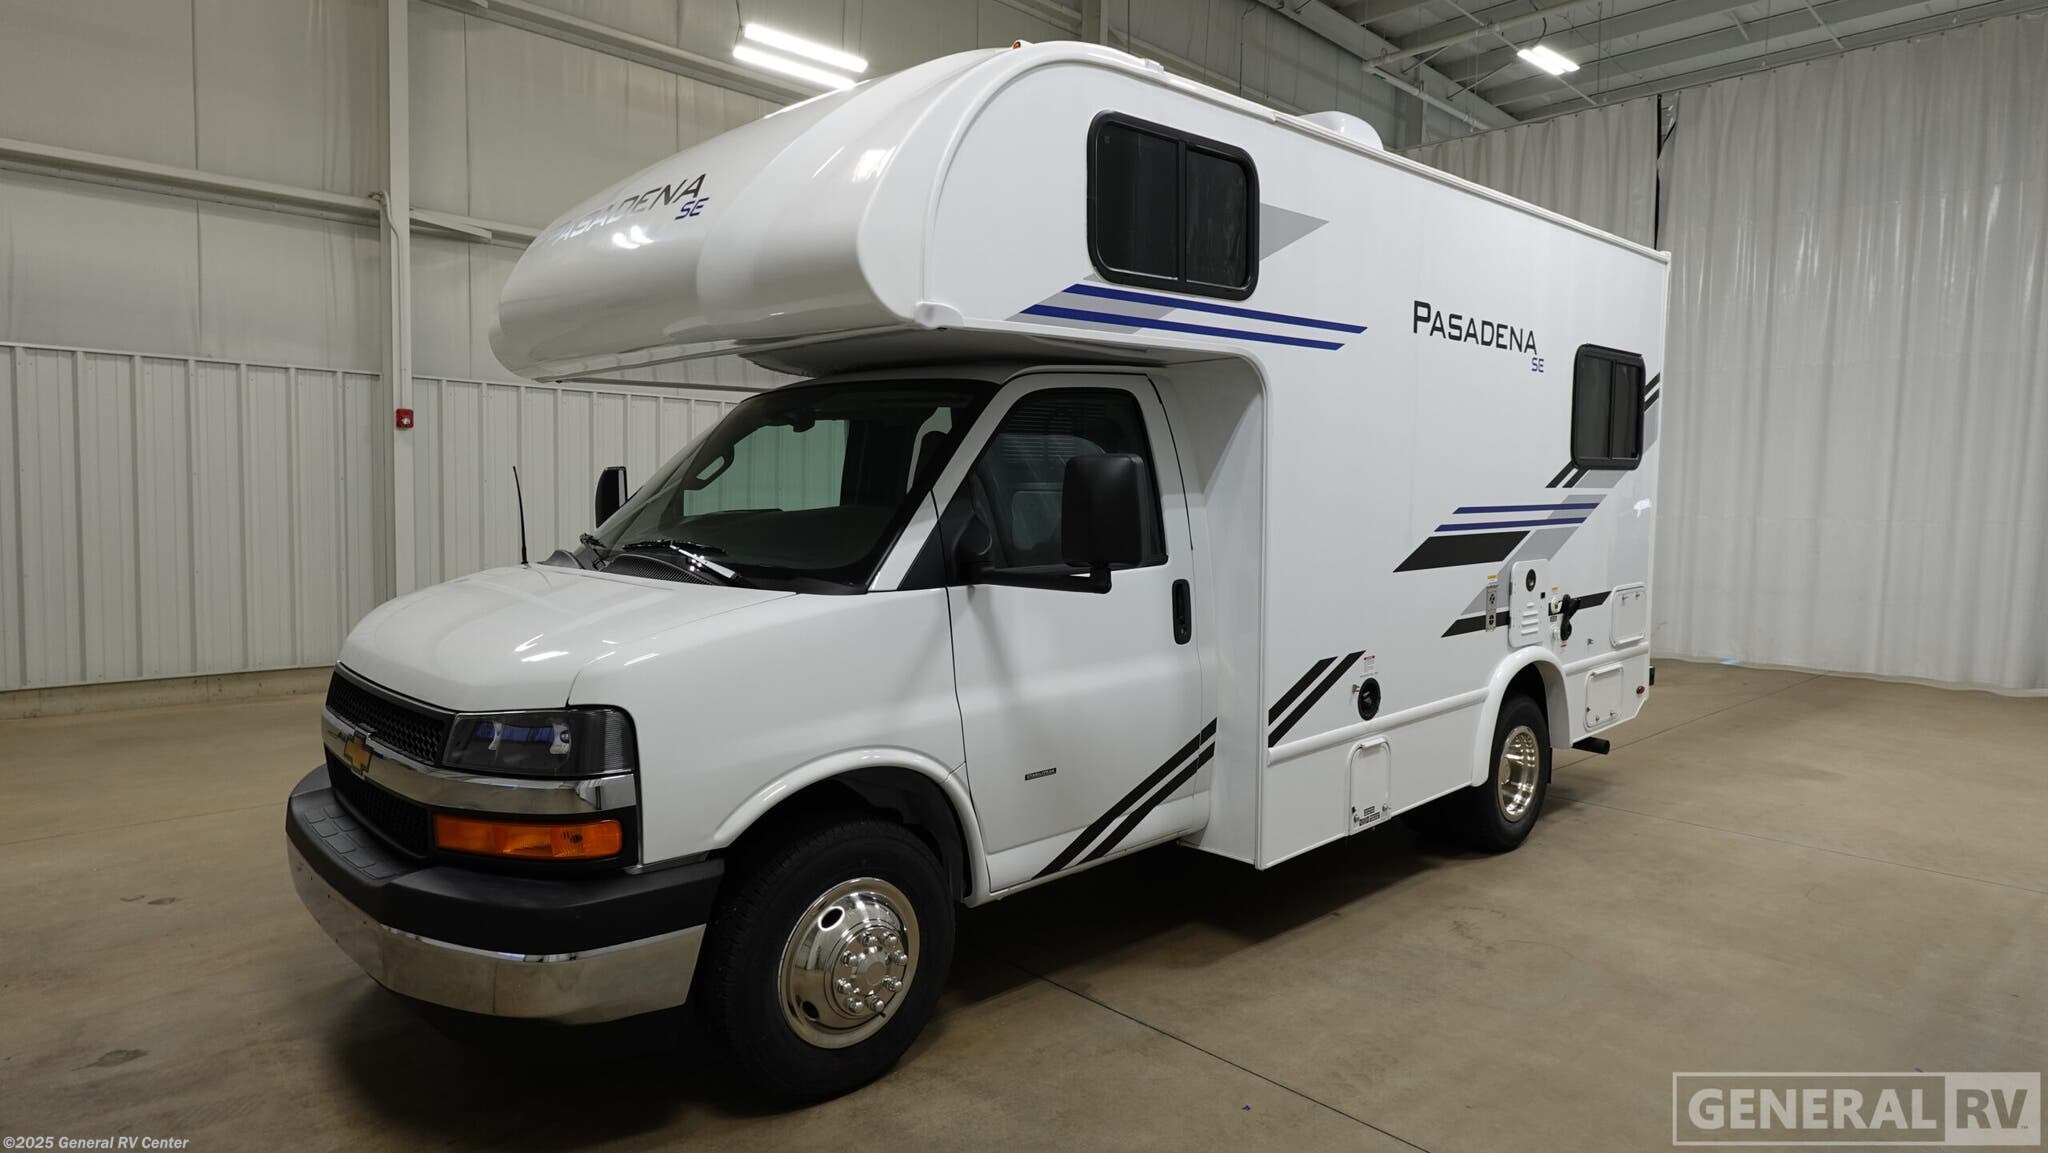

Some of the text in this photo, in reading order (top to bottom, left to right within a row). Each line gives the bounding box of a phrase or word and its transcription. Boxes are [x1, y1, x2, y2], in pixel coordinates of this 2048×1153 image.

[674, 196, 710, 221] SE
[1412, 300, 1538, 355] PASADENA
[1531, 356, 1545, 373] SE
